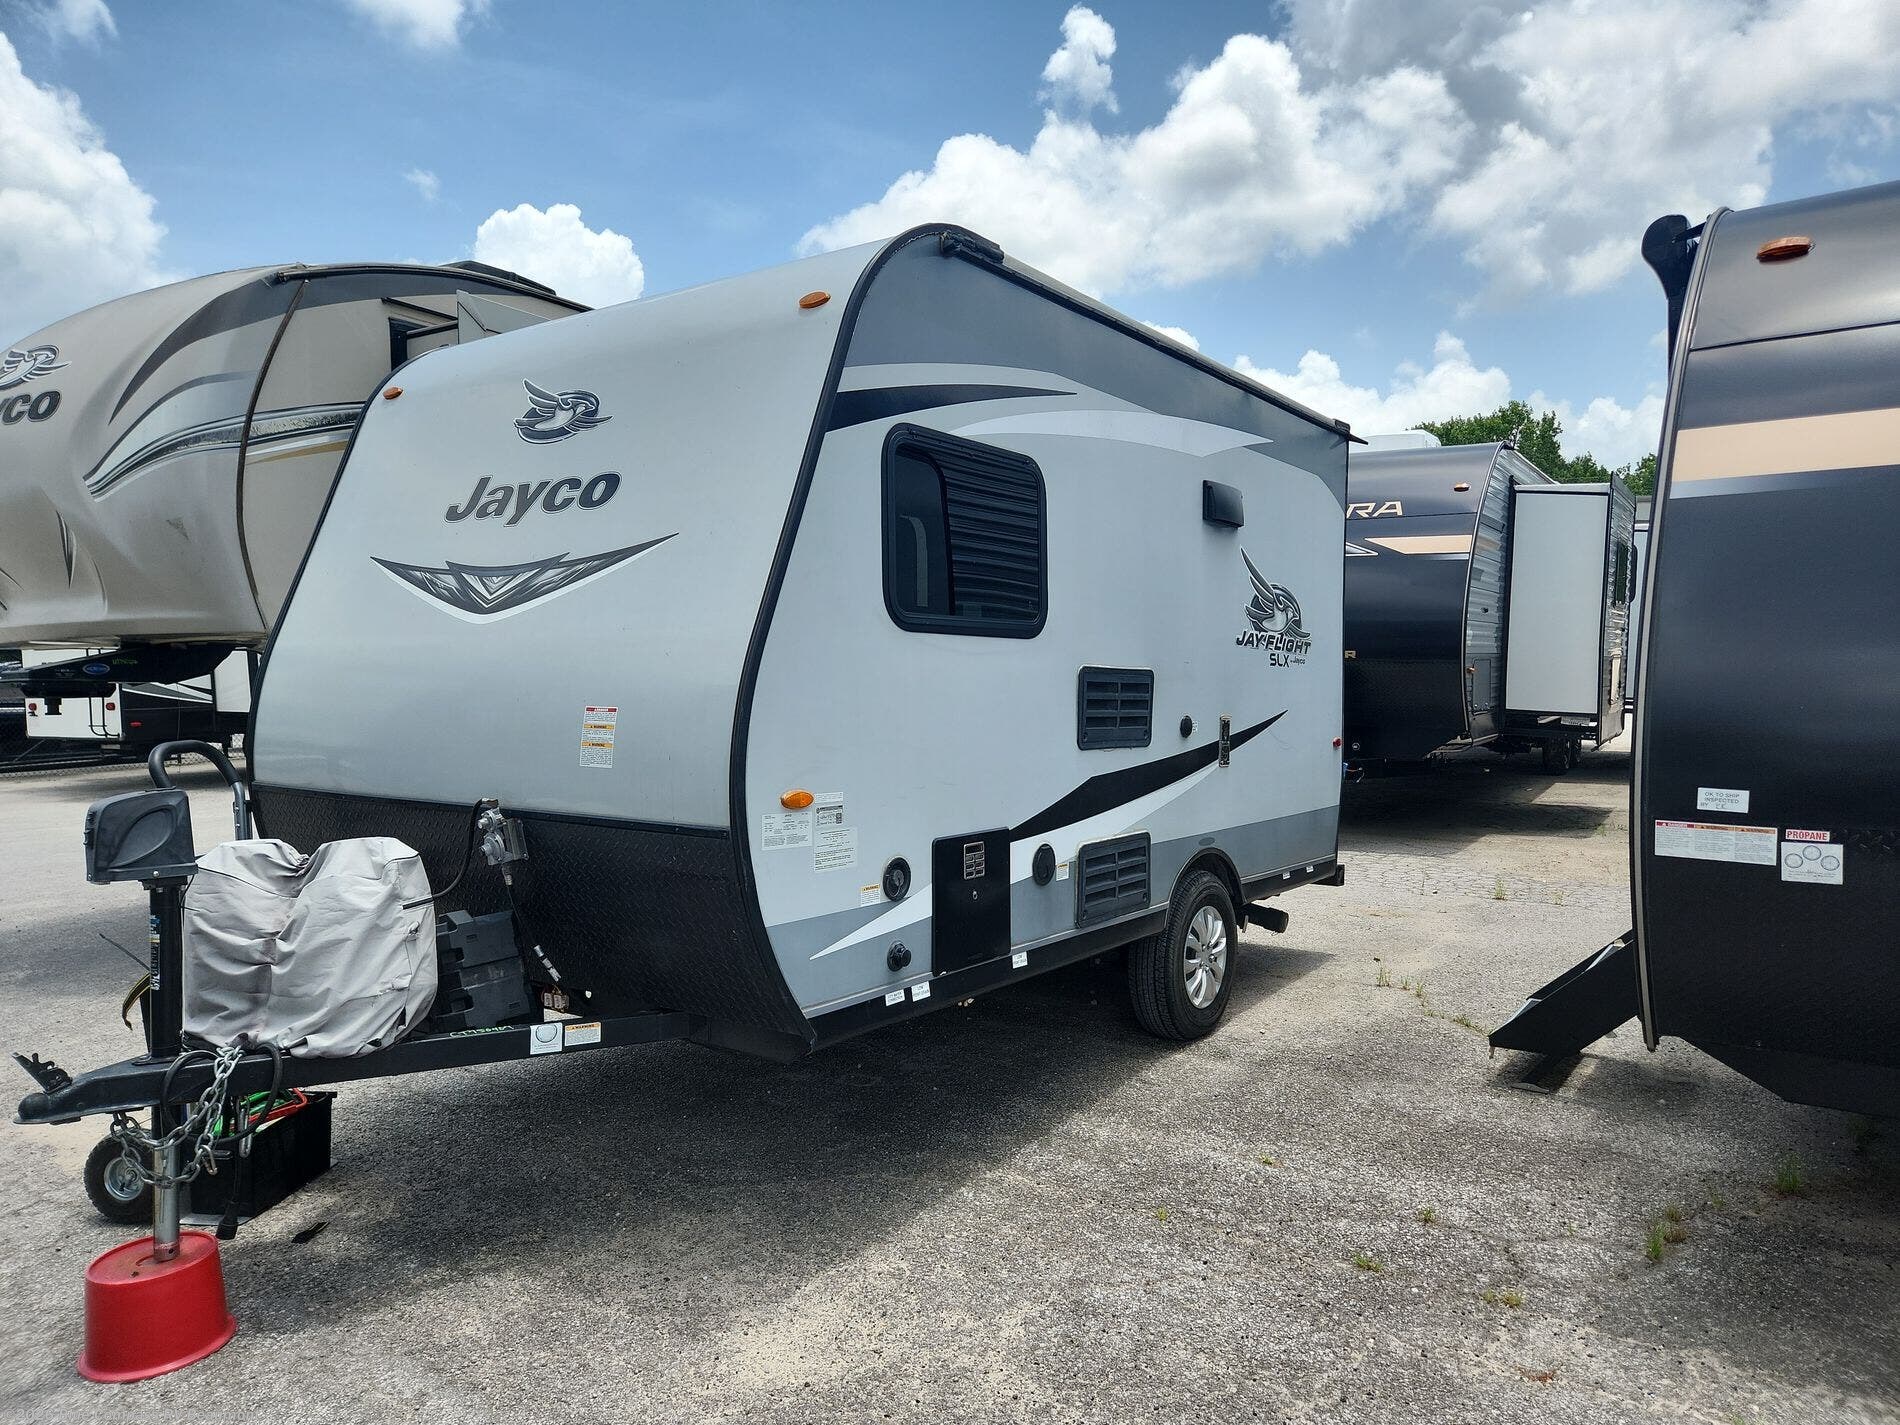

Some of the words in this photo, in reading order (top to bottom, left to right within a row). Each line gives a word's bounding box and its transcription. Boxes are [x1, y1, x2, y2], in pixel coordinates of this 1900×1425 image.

[444, 470, 623, 528] Jayco
[1269, 653, 1290, 668] SLX
[1786, 830, 1828, 841] PROPANE
